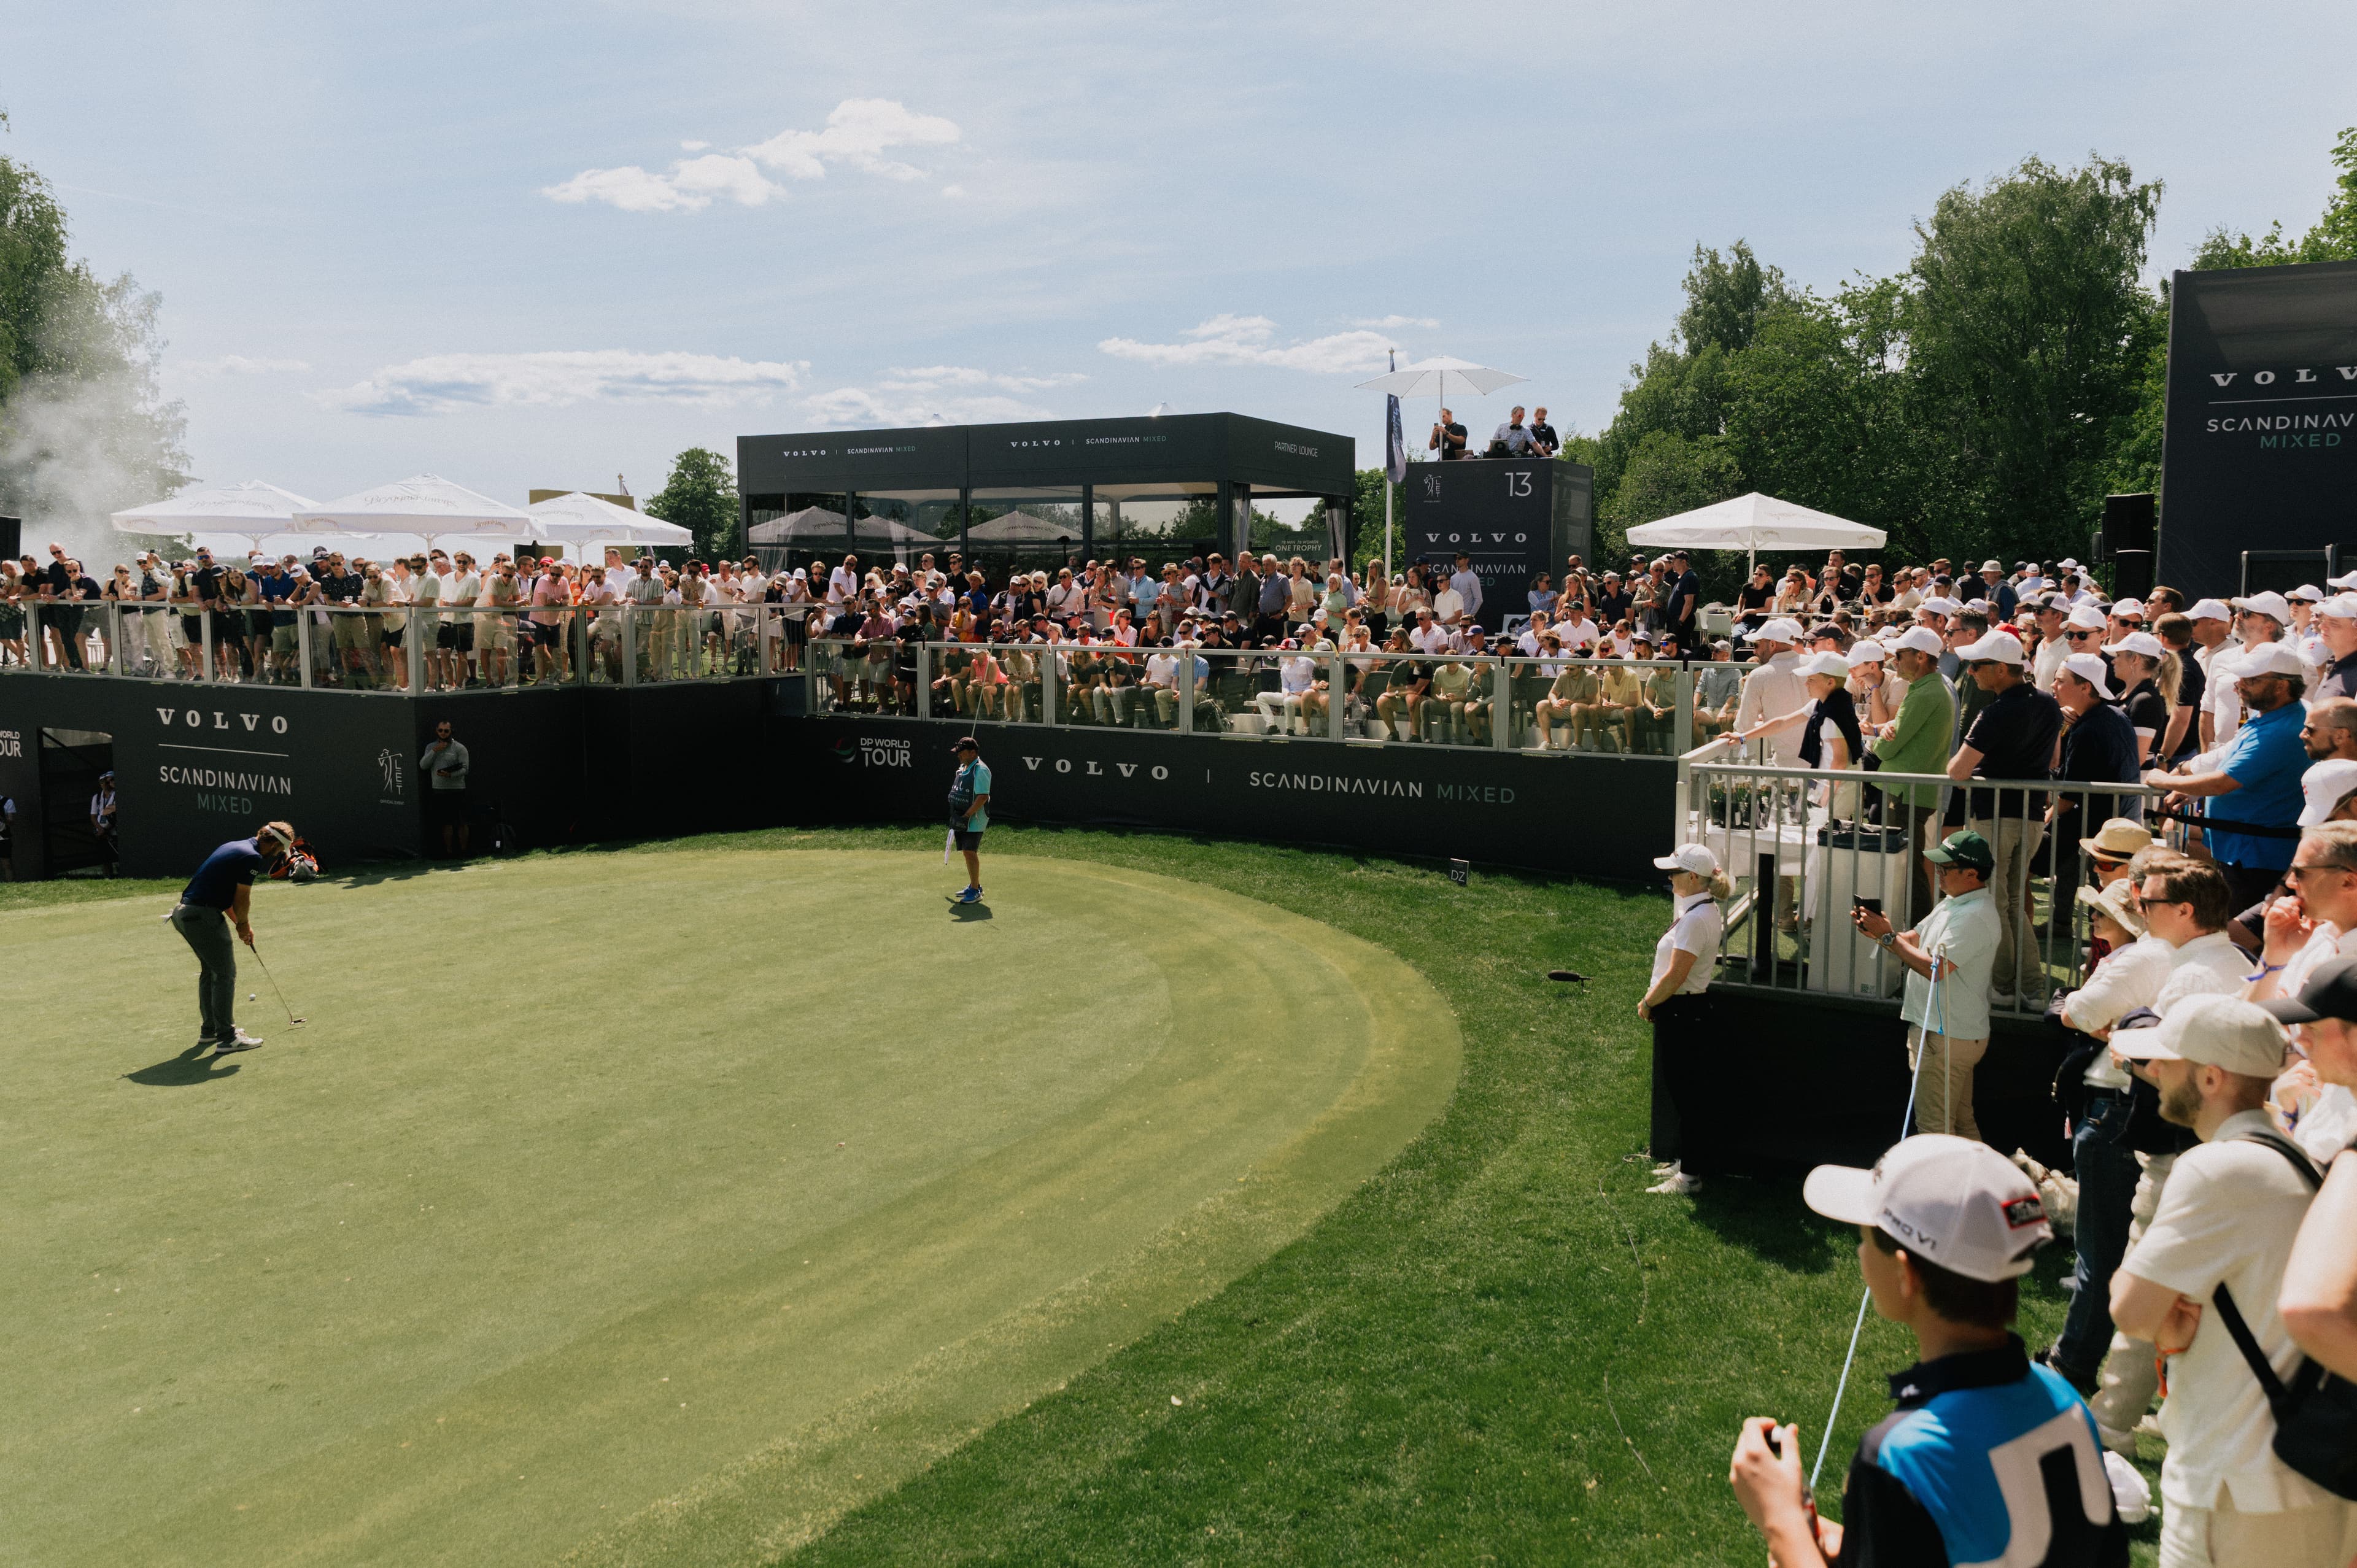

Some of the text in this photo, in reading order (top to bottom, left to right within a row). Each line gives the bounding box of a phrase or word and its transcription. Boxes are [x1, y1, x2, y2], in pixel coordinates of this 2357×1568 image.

[2210, 366, 2357, 387] VOLV
[2207, 413, 2355, 432] SCANDINAV
[1274, 441, 1318, 457] PARTNER LOUNGE
[2260, 433, 2341, 449] MIXED
[1505, 472, 1532, 496] 13
[1426, 533, 1527, 543] VOLVO
[1428, 564, 1526, 574] SCANINAVIAN
[157, 708, 288, 734] VOLVO
[861, 738, 910, 749] DP WORLD
[861, 747, 912, 768] TOUR
[160, 766, 291, 795] SCANDINAVIAN
[1022, 757, 1515, 804] VOLVO SCANDINAVIAN MIXED
[198, 793, 252, 814] MIXED
[1451, 870, 1465, 882] DZ
